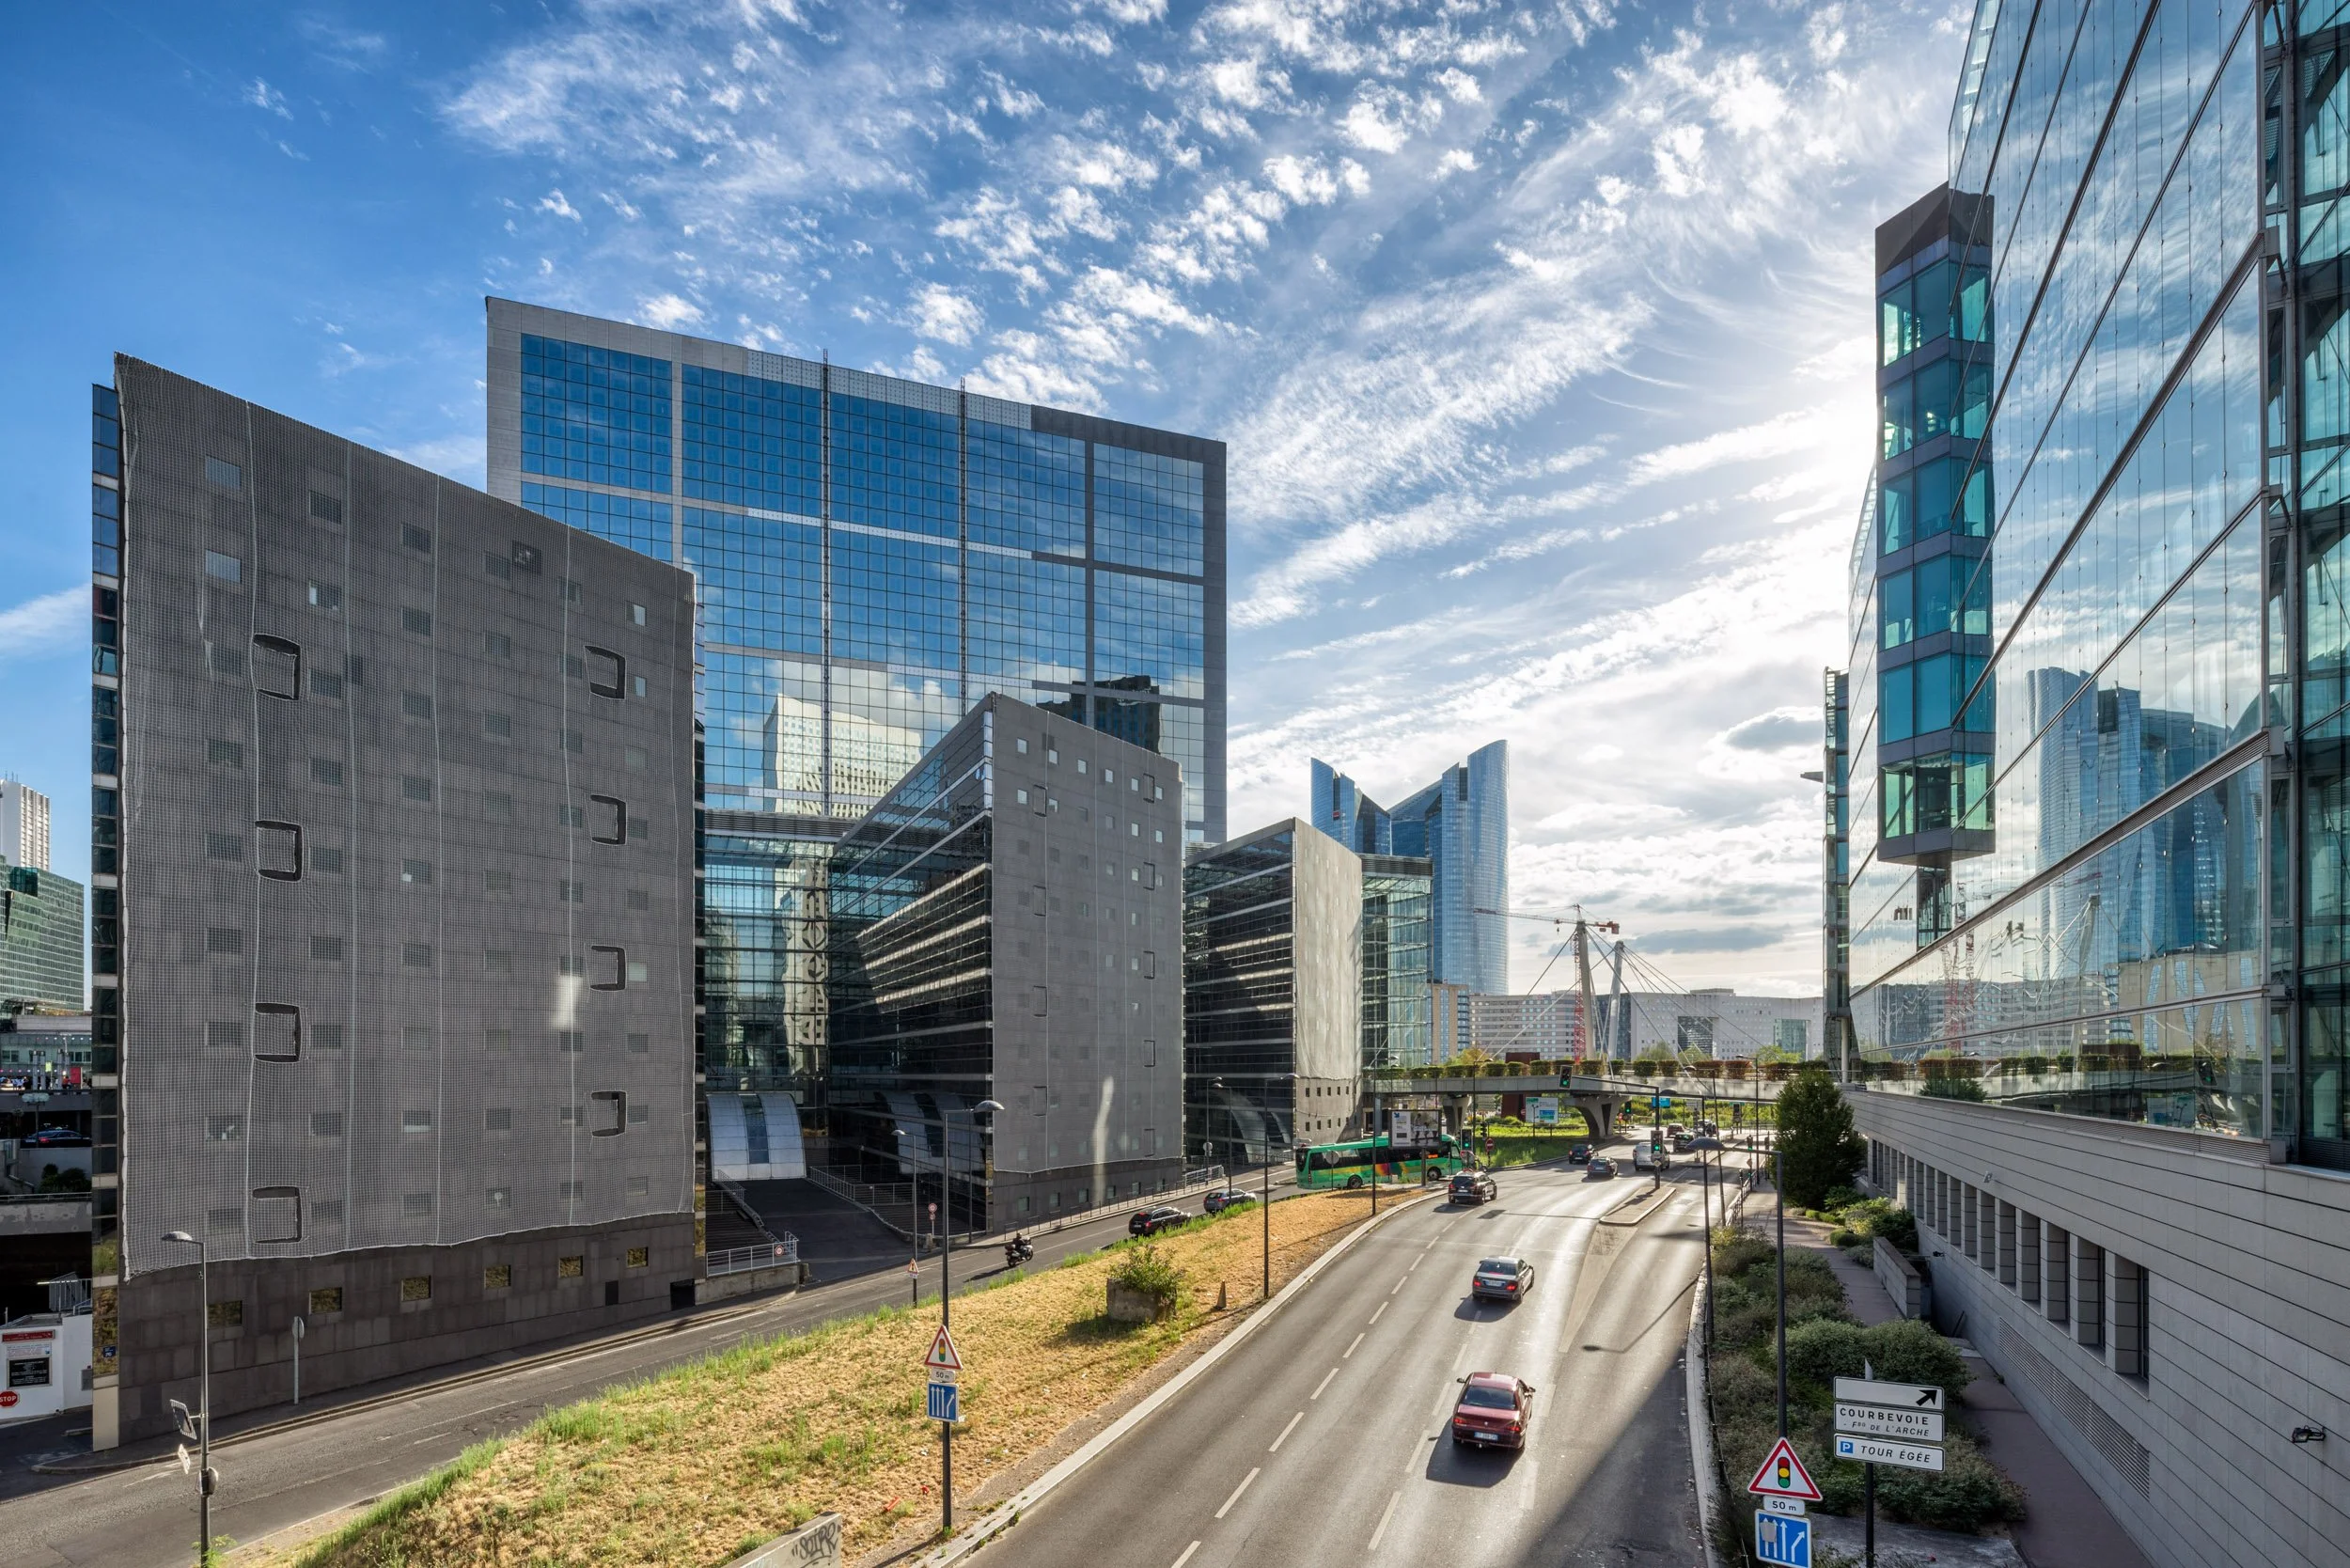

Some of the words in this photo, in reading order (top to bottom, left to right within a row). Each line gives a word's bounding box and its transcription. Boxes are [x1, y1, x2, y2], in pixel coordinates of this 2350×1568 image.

[1840, 1407, 1929, 1425] COURBEVOIE
[1886, 1424, 1930, 1437] L'ARCHE
[1860, 1445, 1893, 1458] TOUR
[1900, 1450, 1931, 1463] ÉGÉE
[1772, 1500, 1786, 1510] 50
